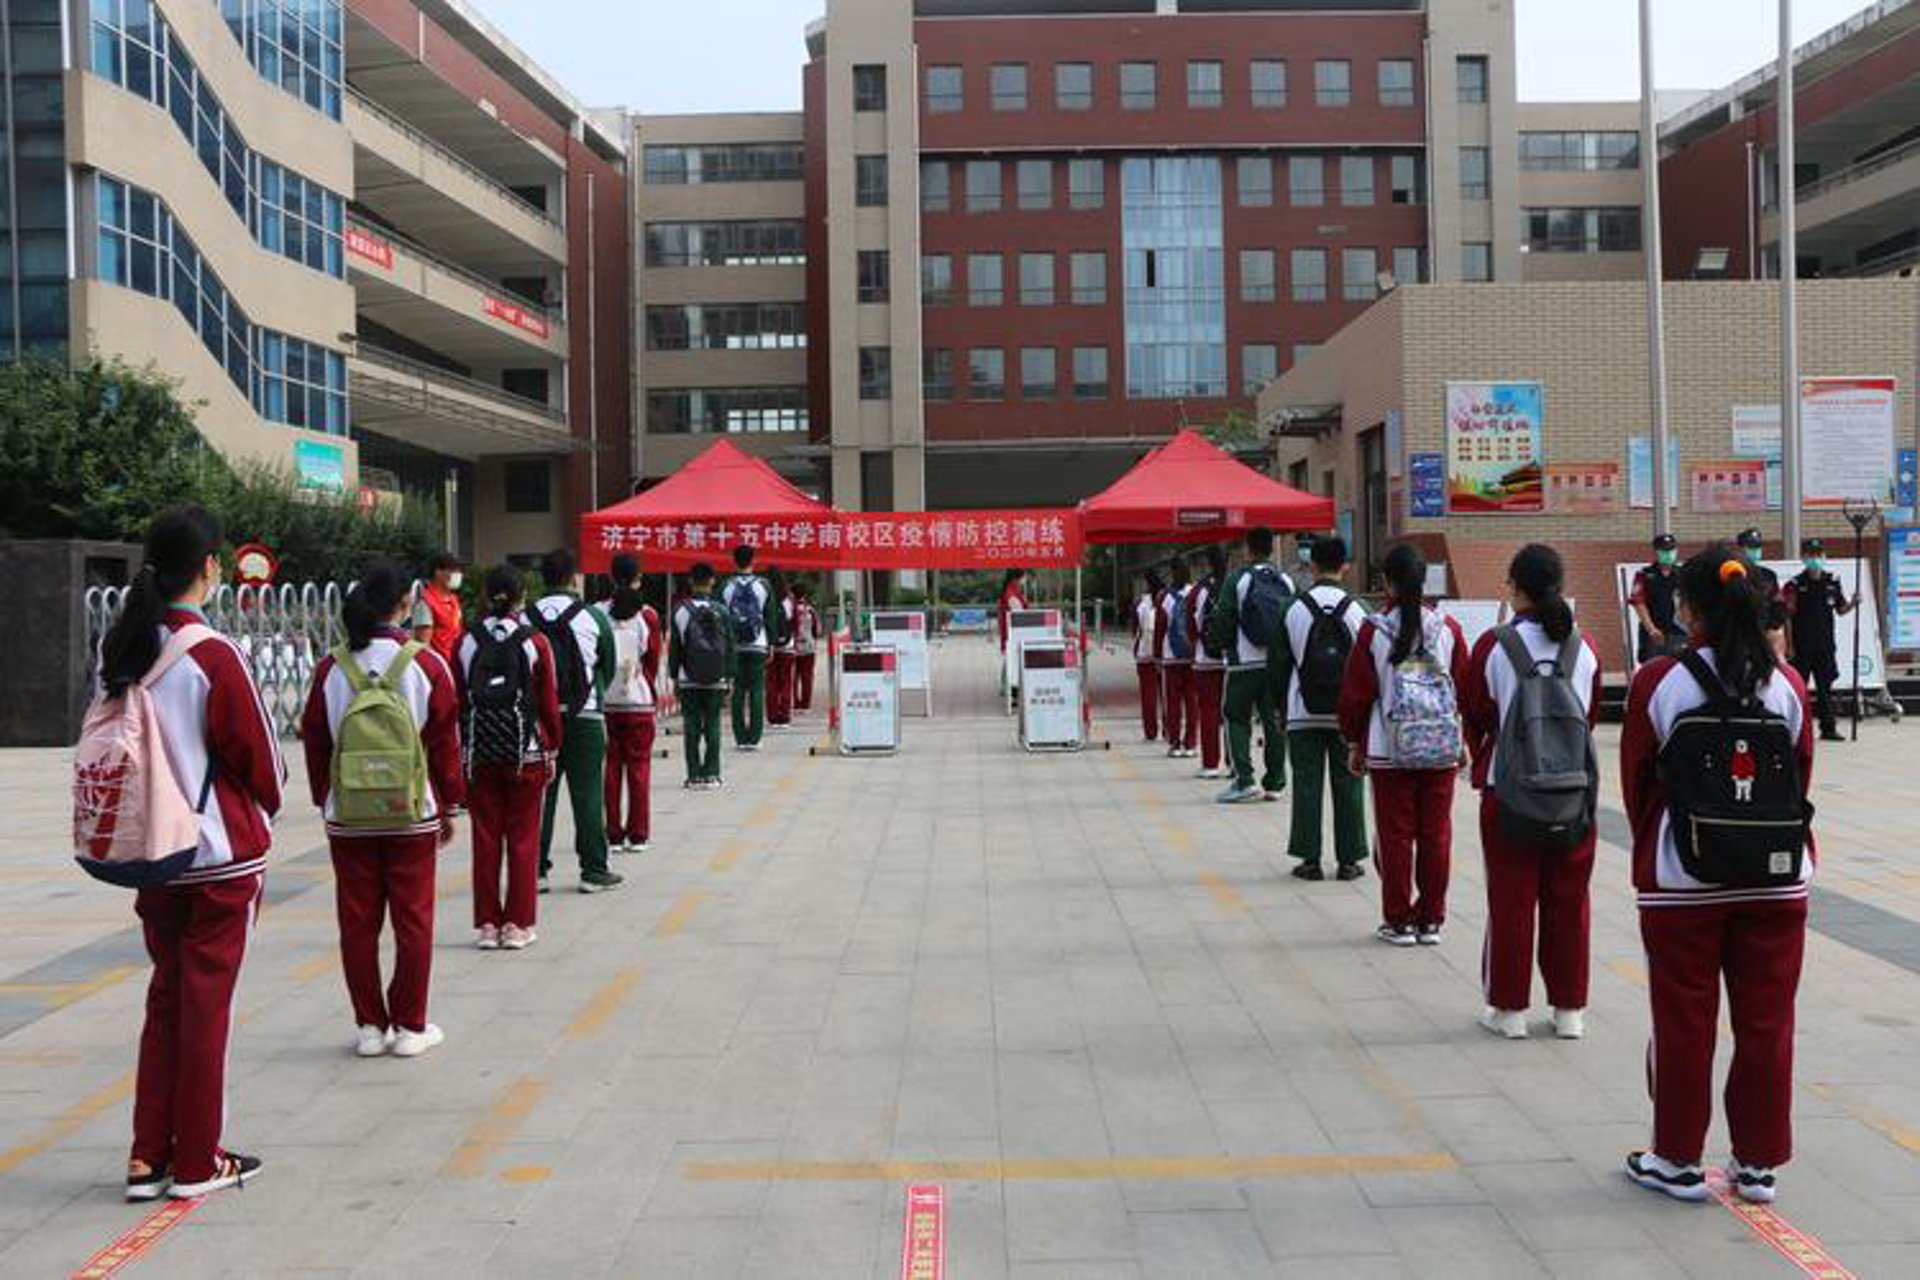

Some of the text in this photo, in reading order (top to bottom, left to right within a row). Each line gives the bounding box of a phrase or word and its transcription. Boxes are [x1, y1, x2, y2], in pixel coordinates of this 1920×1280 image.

[601, 518, 1064, 549] 济宁市第十五中学南校区疫情防控演练
